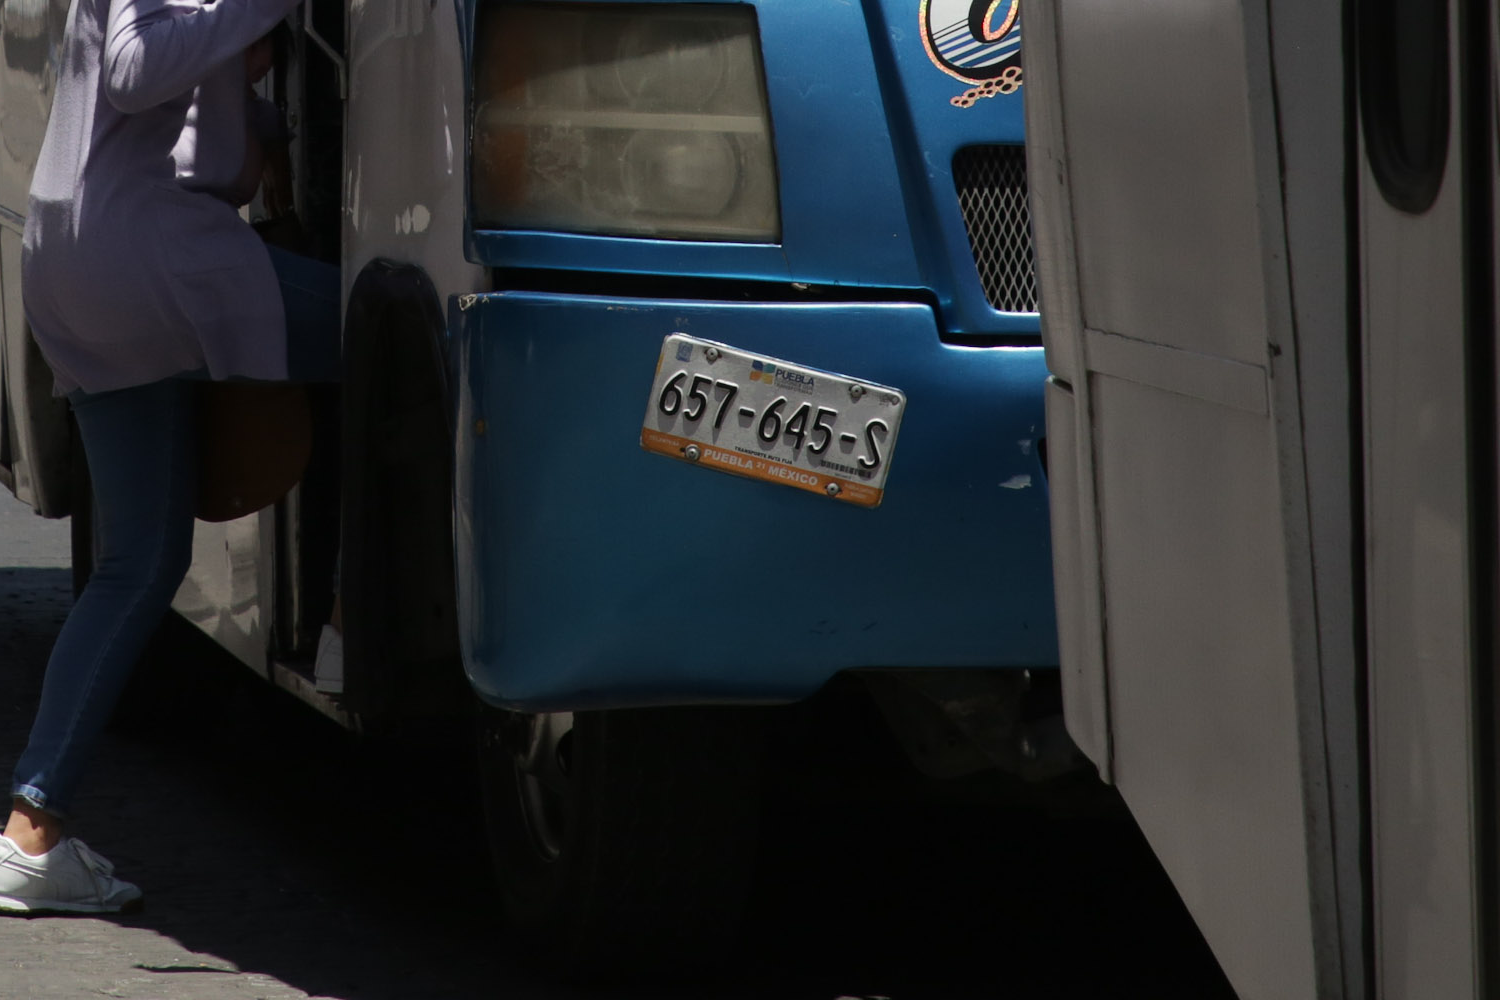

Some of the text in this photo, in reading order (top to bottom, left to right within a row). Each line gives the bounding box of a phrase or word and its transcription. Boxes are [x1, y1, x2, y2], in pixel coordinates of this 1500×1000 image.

[775, 368, 815, 387] PUEBLA
[659, 370, 888, 470] 657-645-S
[703, 448, 754, 470] PUEBLA
[734, 445, 767, 459] TRANSPORTE
